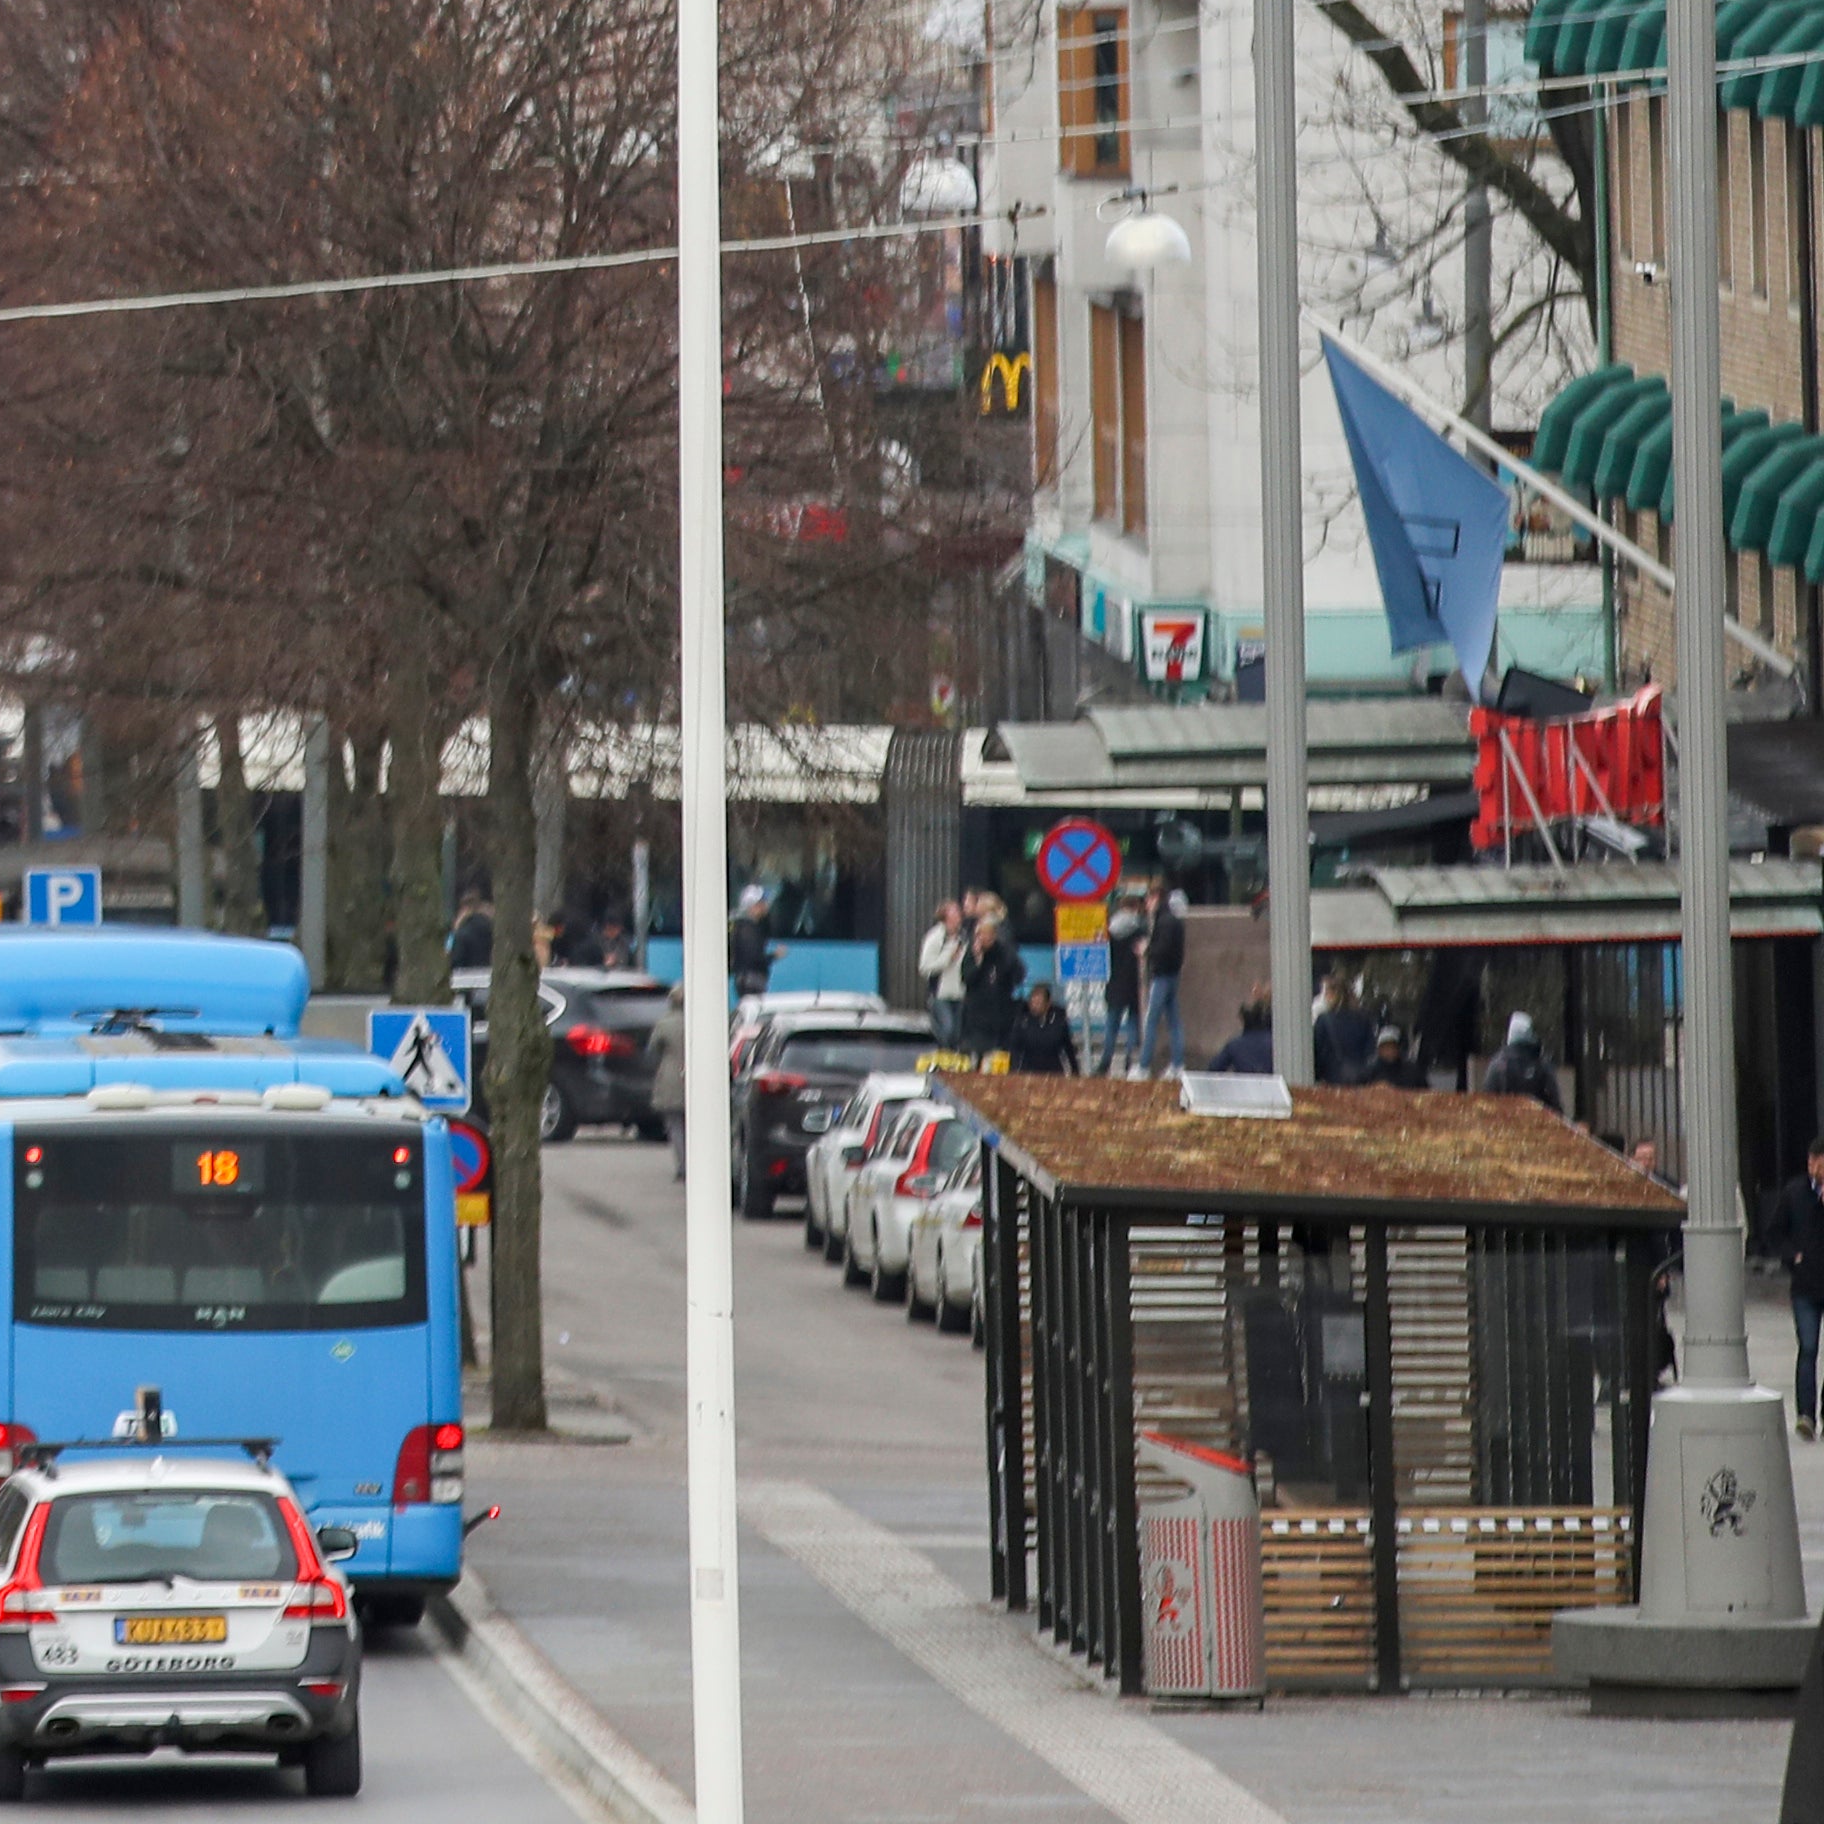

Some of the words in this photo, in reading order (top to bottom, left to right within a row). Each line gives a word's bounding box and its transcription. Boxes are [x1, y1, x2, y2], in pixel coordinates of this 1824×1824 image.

[47, 875, 84, 925] P
[41, 1643, 79, 1666] 483
[105, 1655, 237, 1673] GÖTEBORG
